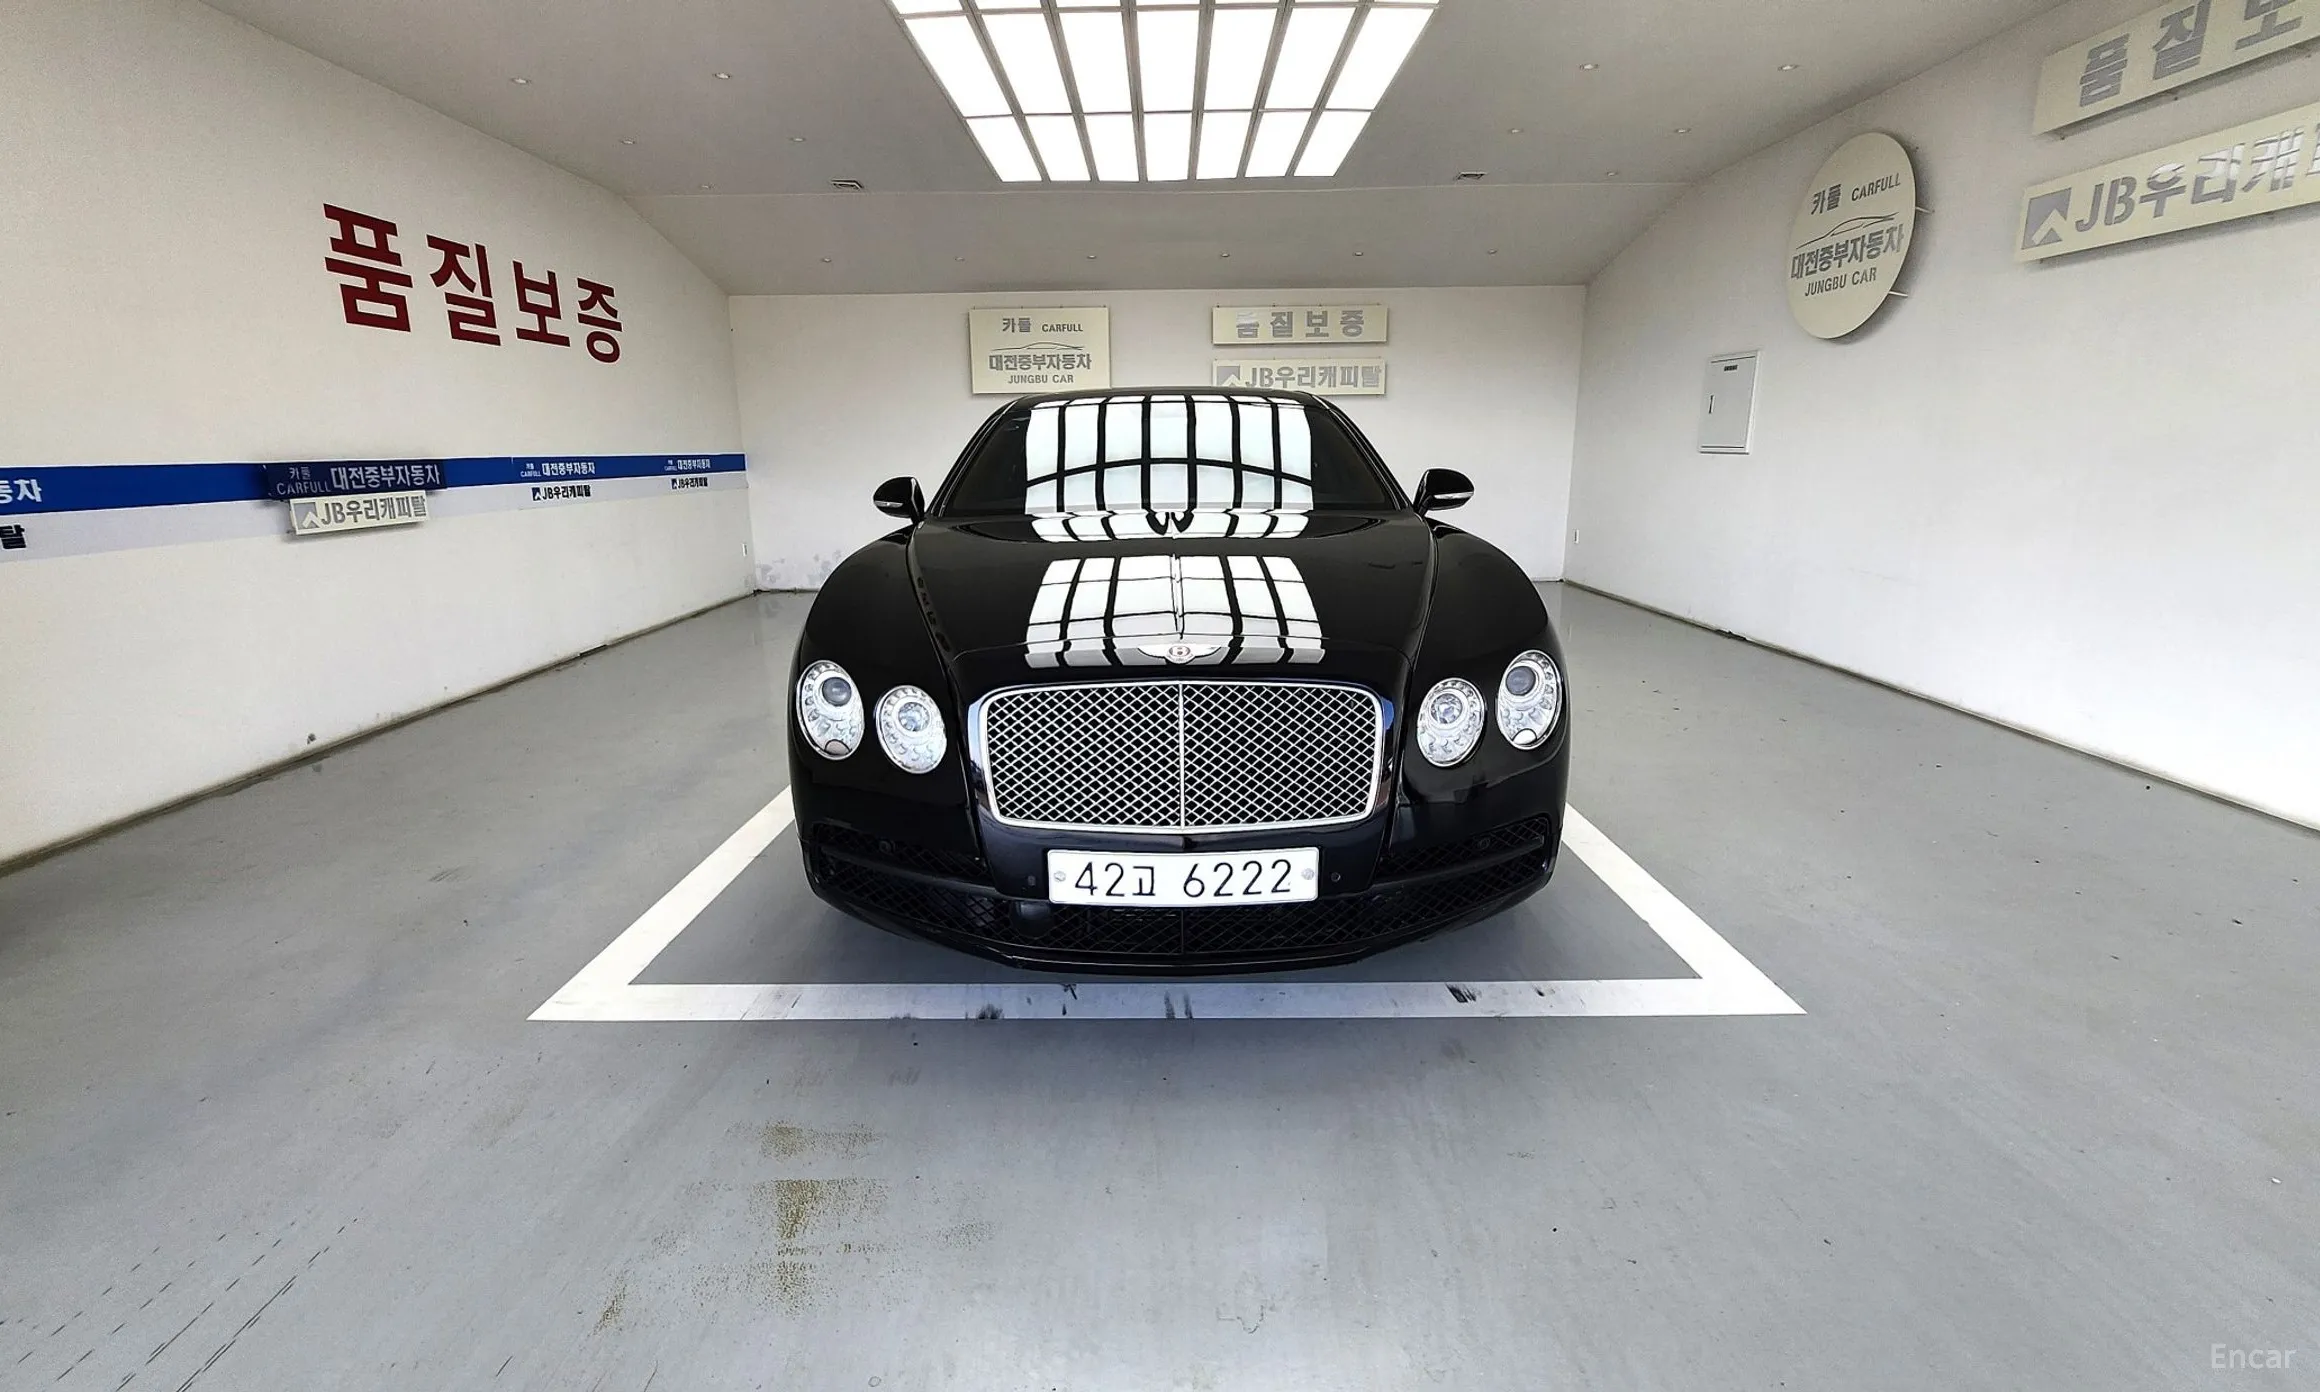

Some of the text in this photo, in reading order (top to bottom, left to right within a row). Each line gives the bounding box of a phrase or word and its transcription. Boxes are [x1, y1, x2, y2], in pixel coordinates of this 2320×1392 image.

[1811, 173, 1901, 215] 카풀 CARFULL
[1791, 223, 1904, 279] 대전중부자동차
[323, 203, 622, 363] 품질보증
[1805, 267, 1877, 297] JUNGBU CAR
[1002, 317, 1083, 333] 카풀 CARFULL
[989, 353, 1092, 371] 대전중부자동차
[1245, 365, 1382, 389] JB우리캐피탈
[1008, 374, 1074, 384] JUNGBU CAR
[276, 464, 440, 496] CARFULL 대전중부자동차
[321, 495, 427, 525] JB우리캐피탈
[1074, 858, 1292, 898] 42고 6222
